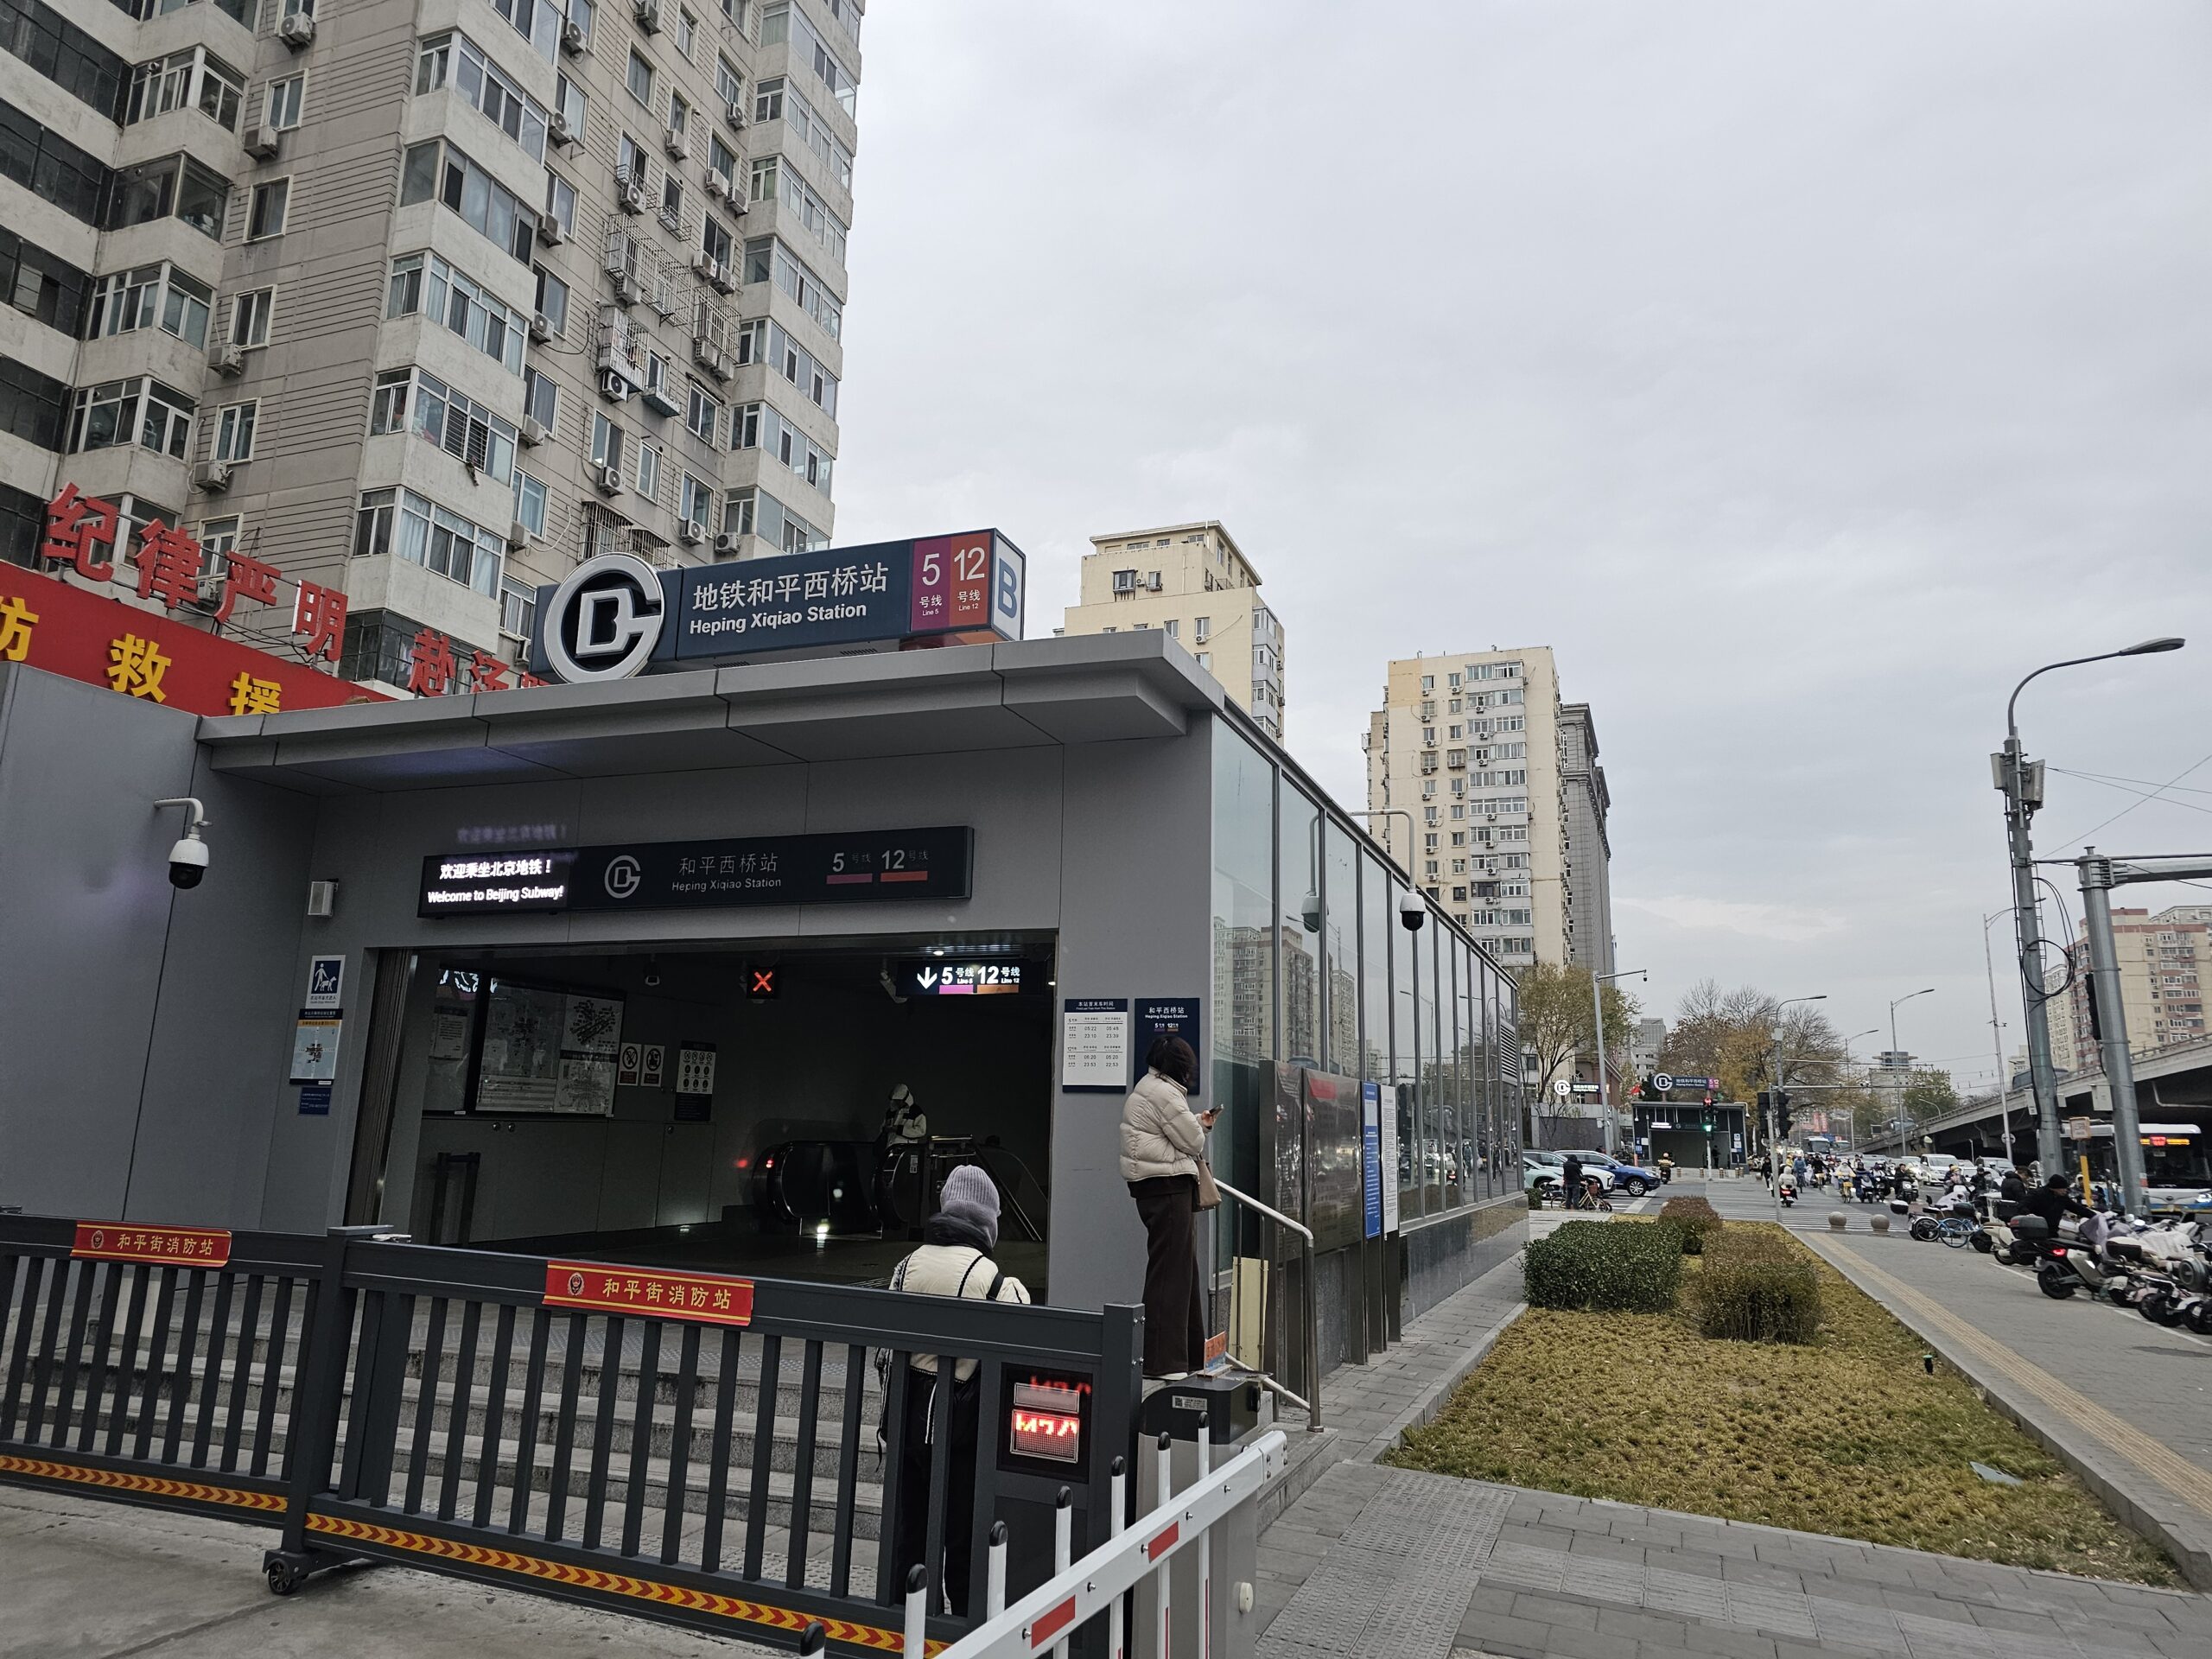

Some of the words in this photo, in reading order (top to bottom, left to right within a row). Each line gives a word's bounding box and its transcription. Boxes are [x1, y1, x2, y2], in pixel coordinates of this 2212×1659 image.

[922, 553, 940, 586] 5
[954, 547, 985, 581] 12
[41, 481, 348, 662] 纪律严明
[407, 628, 551, 697] 赴汤
[692, 563, 888, 611] 地铁和平西桥站
[957, 589, 981, 603] 号线
[998, 557, 1017, 619] B
[919, 594, 943, 608] 号线
[690, 617, 747, 636] Heping
[750, 610, 802, 629] Xiqiao
[807, 604, 867, 622] Station
[678, 853, 779, 876] 和平西桥站
[832, 853, 845, 872] 5
[881, 849, 905, 869] 12
[428, 891, 472, 903] Welcome
[474, 890, 484, 901] to
[486, 888, 520, 903] Beijing
[520, 885, 564, 900] Subway!
[672, 881, 707, 892] Heping
[709, 880, 741, 890] Xiqiao
[745, 878, 781, 888] Station
[941, 967, 953, 984] 5
[956, 967, 974, 977] 号线
[977, 966, 999, 984] 12
[1001, 967, 1020, 977] 号线
[118, 1233, 213, 1255] 和平街消防站
[602, 1278, 732, 1310] 和平街消防站
